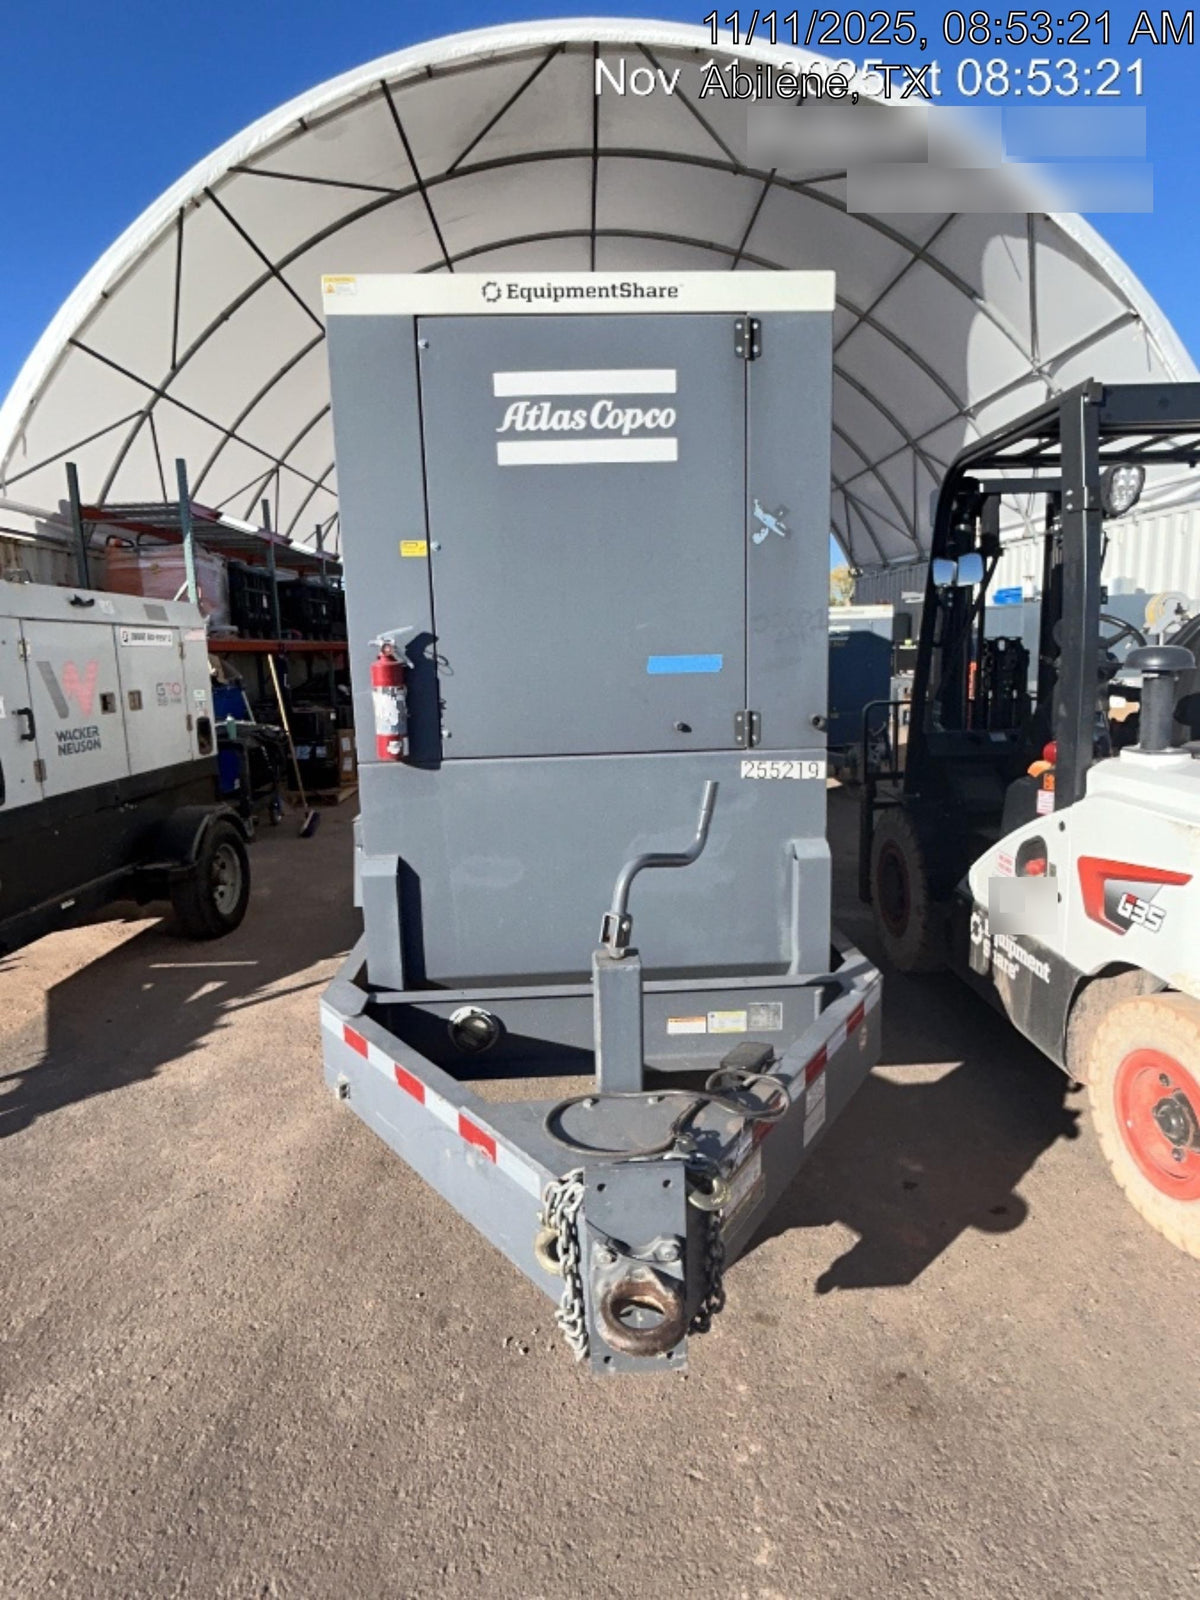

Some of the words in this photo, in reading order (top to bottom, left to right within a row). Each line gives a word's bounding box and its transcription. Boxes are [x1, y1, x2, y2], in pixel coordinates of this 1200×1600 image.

[506, 282, 679, 303] EquipmentShare
[496, 400, 587, 433] Atlas
[590, 400, 677, 436] Copco
[56, 726, 99, 742] WACKER
[58, 738, 102, 756] NEUSON
[744, 761, 819, 779] 255219
